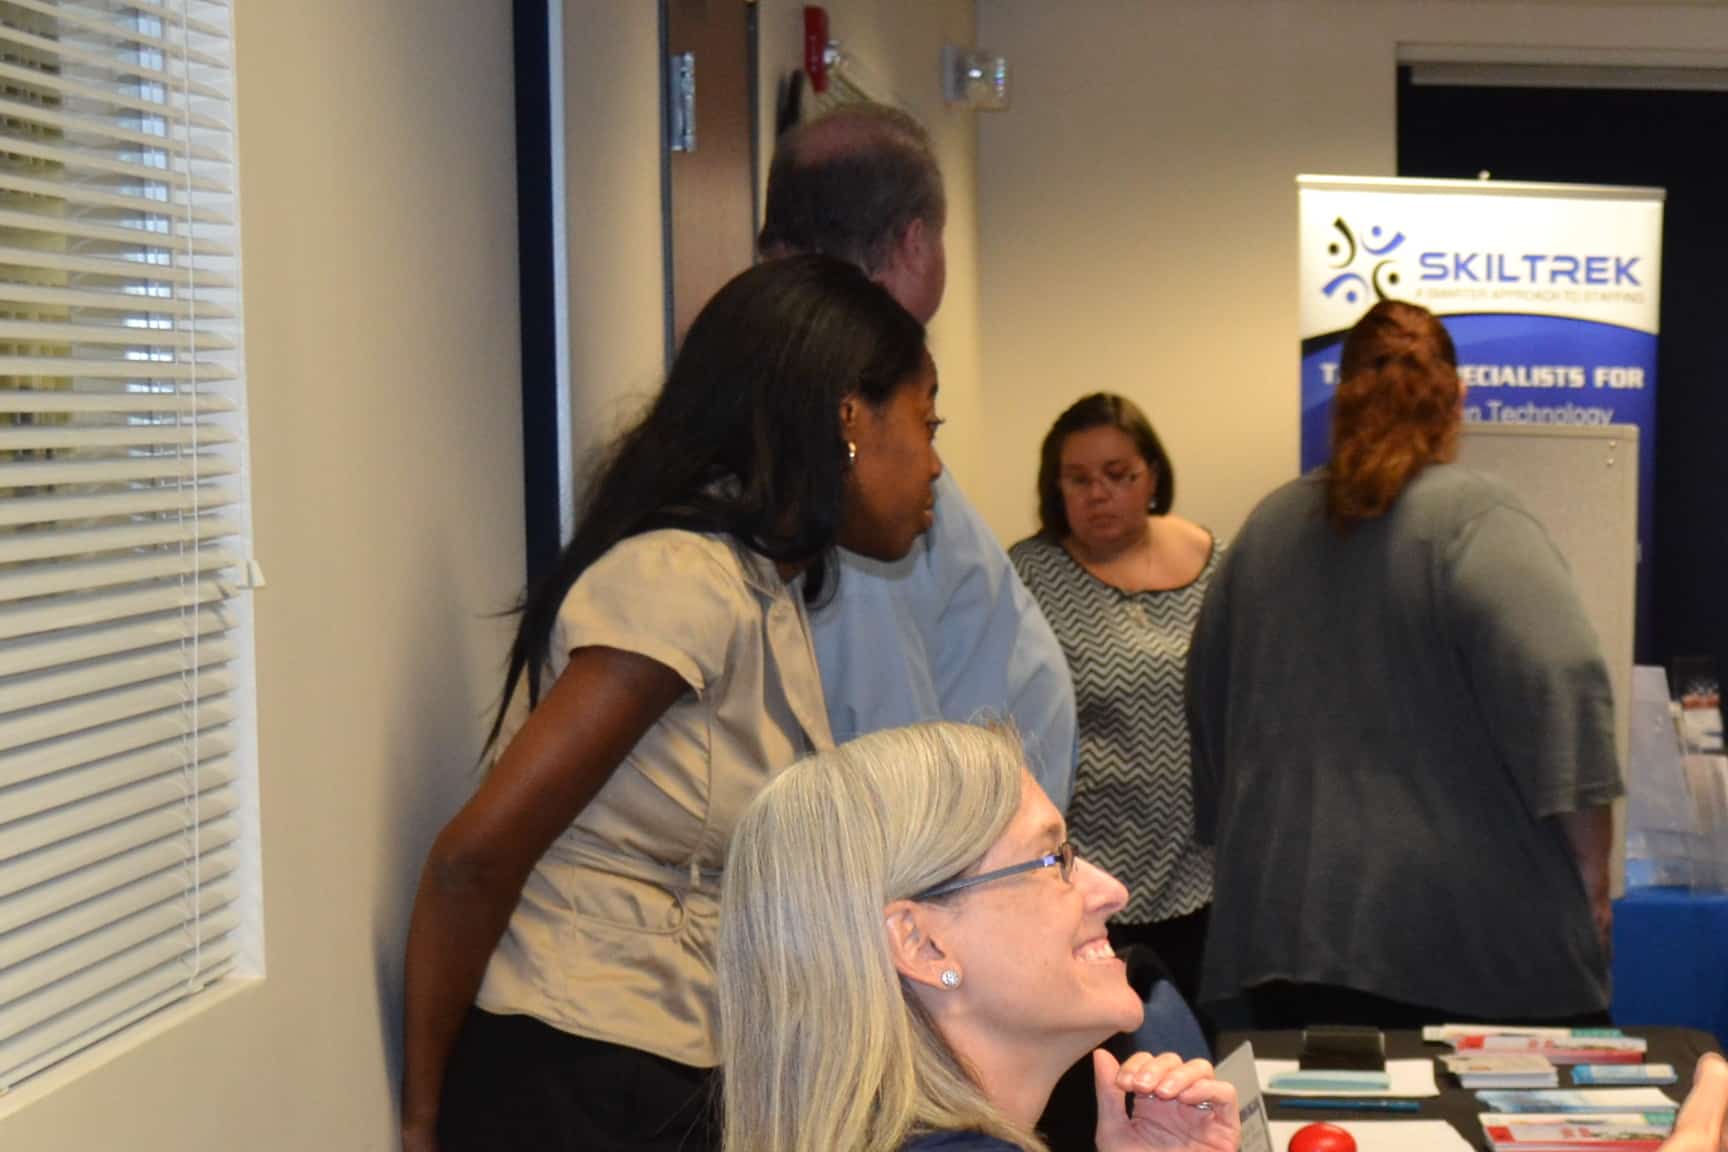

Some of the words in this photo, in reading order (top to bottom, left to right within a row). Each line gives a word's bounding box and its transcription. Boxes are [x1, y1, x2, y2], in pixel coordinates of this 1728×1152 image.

[1418, 252, 1641, 287] SKILTREK
[1457, 365, 1585, 389] ECIALISTS
[1594, 366, 1645, 389] FOR
[1486, 399, 1615, 425] Technology
